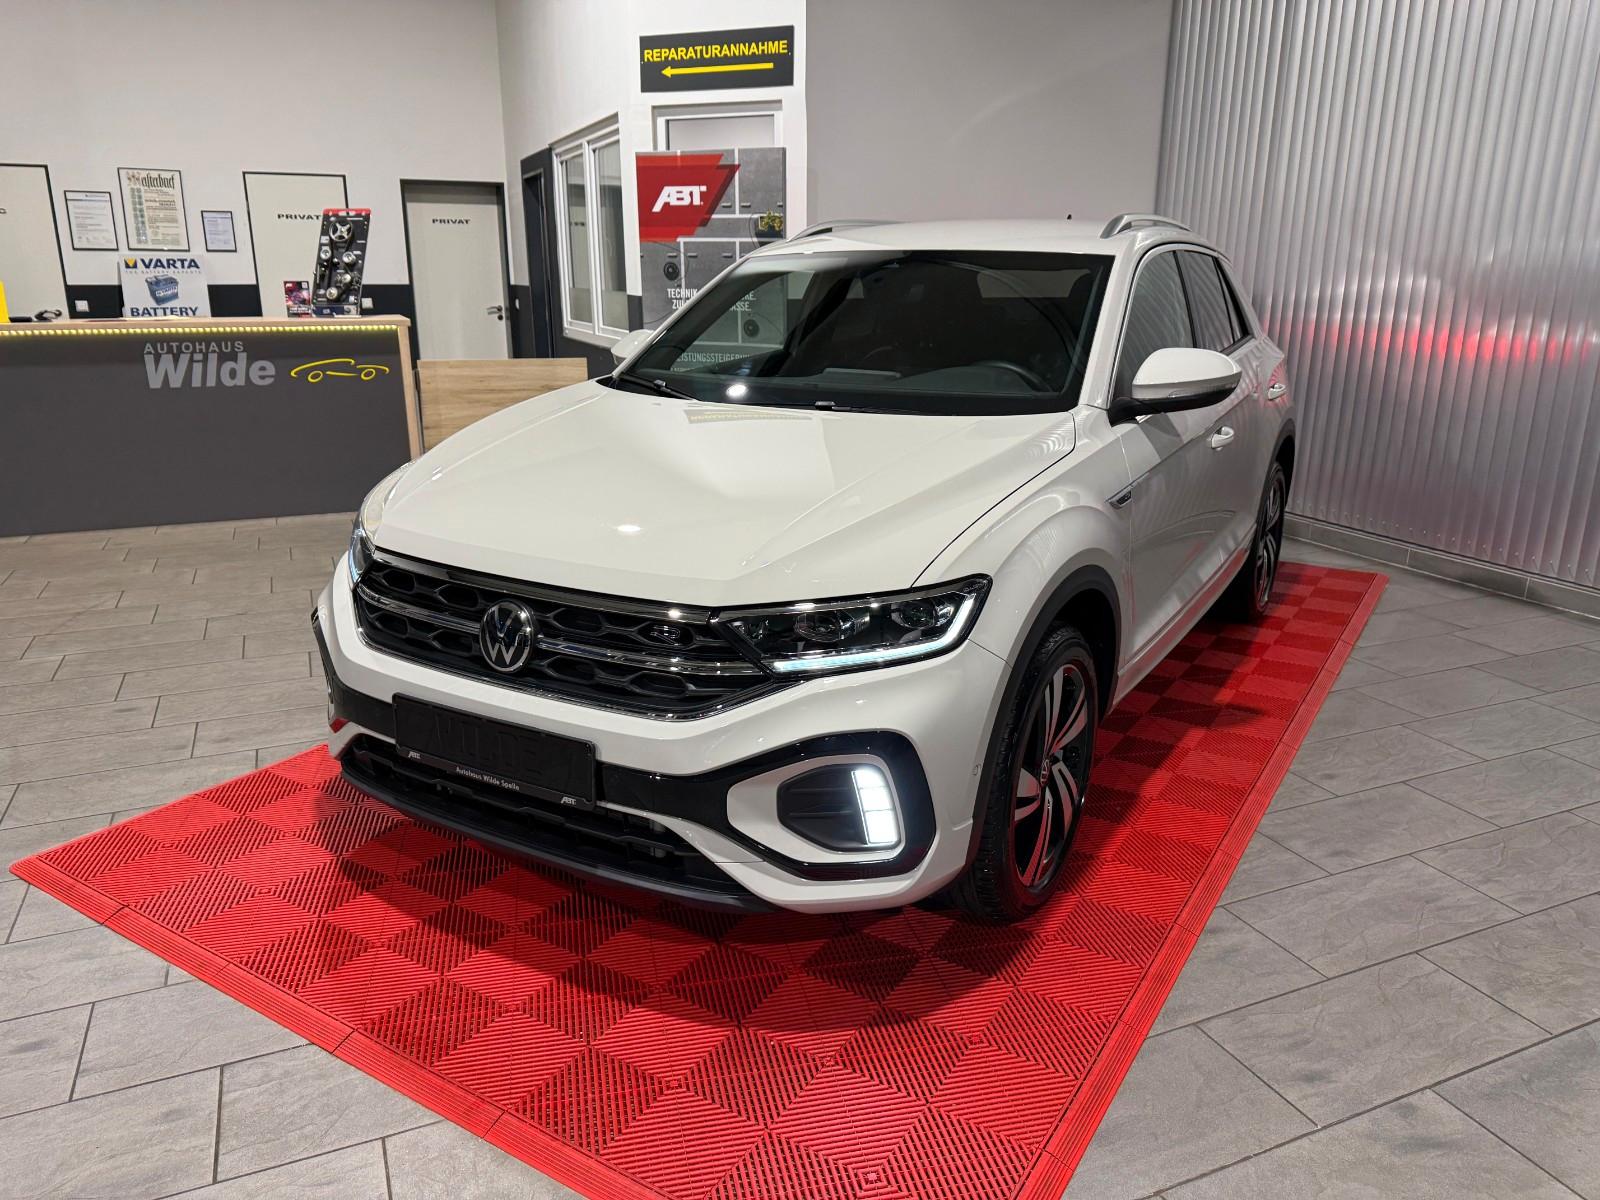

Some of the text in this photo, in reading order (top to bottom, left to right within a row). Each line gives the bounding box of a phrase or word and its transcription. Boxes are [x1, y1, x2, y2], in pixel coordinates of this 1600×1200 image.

[644, 40, 788, 63] REPARATURANNAHME
[652, 185, 707, 212] ABT
[140, 258, 200, 269] VARTA
[130, 306, 198, 317] BATTERY
[143, 341, 244, 354] AUTOHAUS
[143, 352, 276, 389] Wilde
[560, 796, 577, 806] ABT
